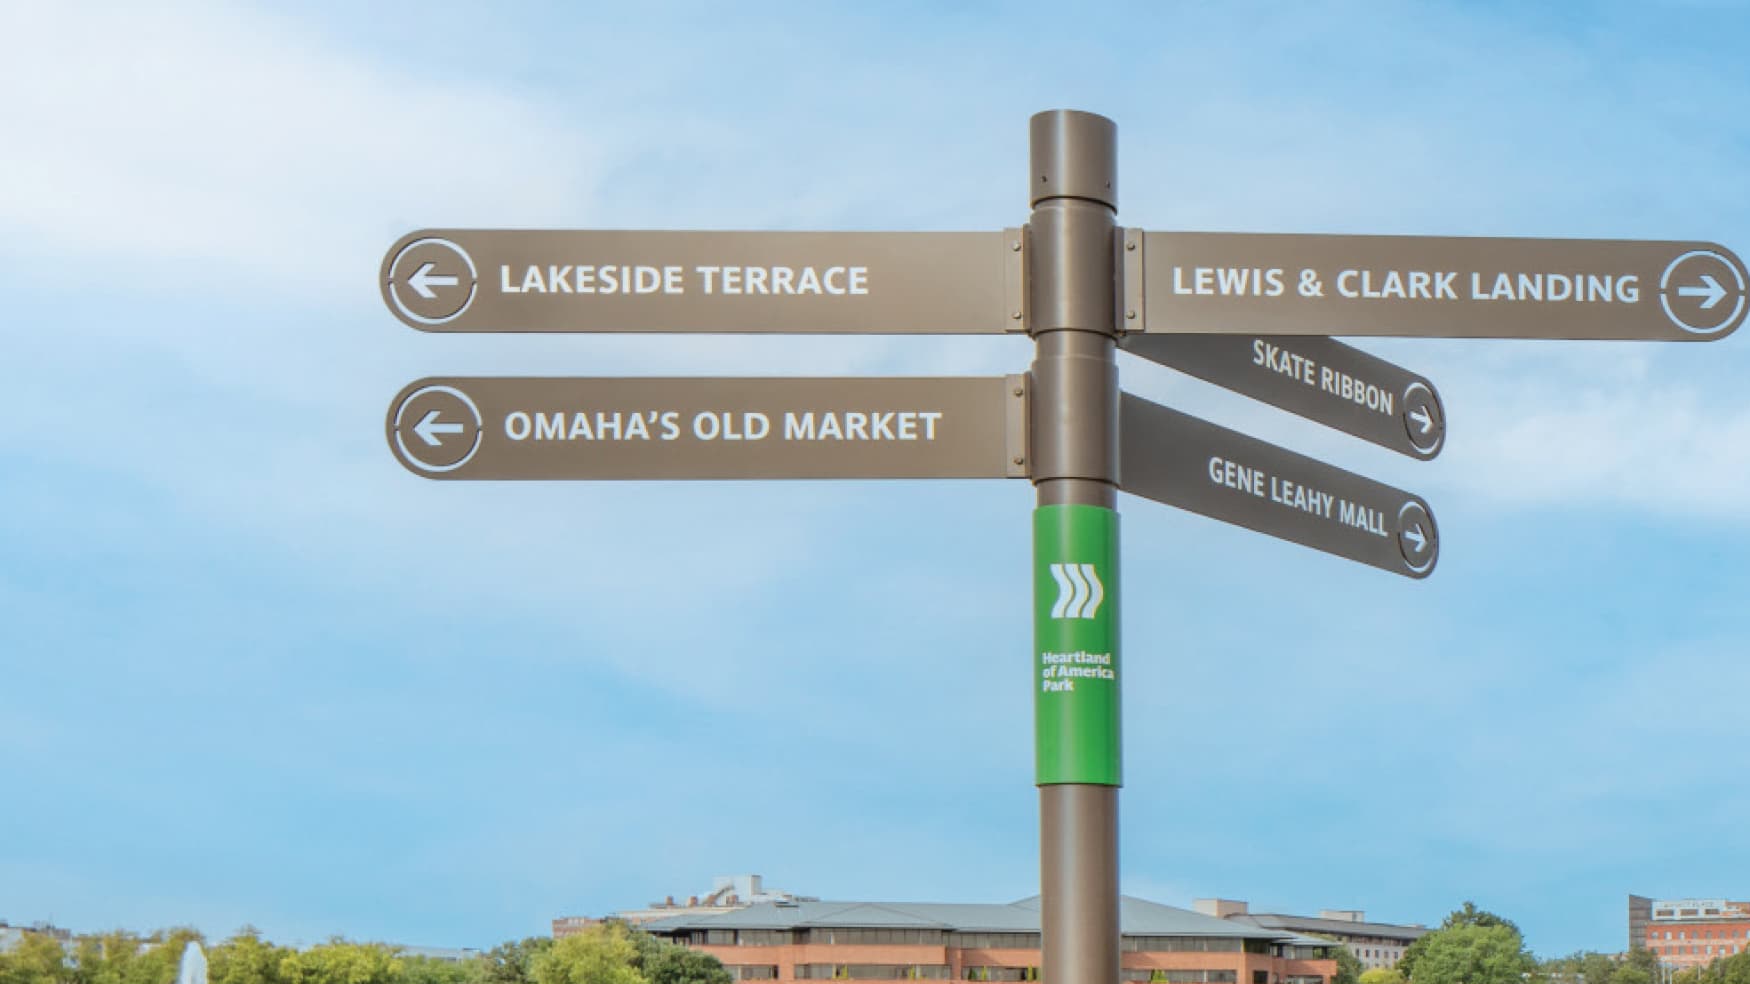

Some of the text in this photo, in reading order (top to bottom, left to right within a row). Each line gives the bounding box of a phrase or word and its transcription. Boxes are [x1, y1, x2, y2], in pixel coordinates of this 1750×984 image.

[501, 265, 869, 295] LAKESIDE TERRACE
[1173, 267, 1639, 303] LEWIS & CLARK LANDING
[1253, 339, 1393, 416] SKATE RIBBON
[505, 411, 943, 441] OMAHA’S OLD MARKET
[1208, 456, 1389, 537] GENE LEAHY MALL
[1042, 651, 1110, 665] Heartland
[1042, 665, 1114, 680] of America
[1043, 679, 1074, 692] Park
